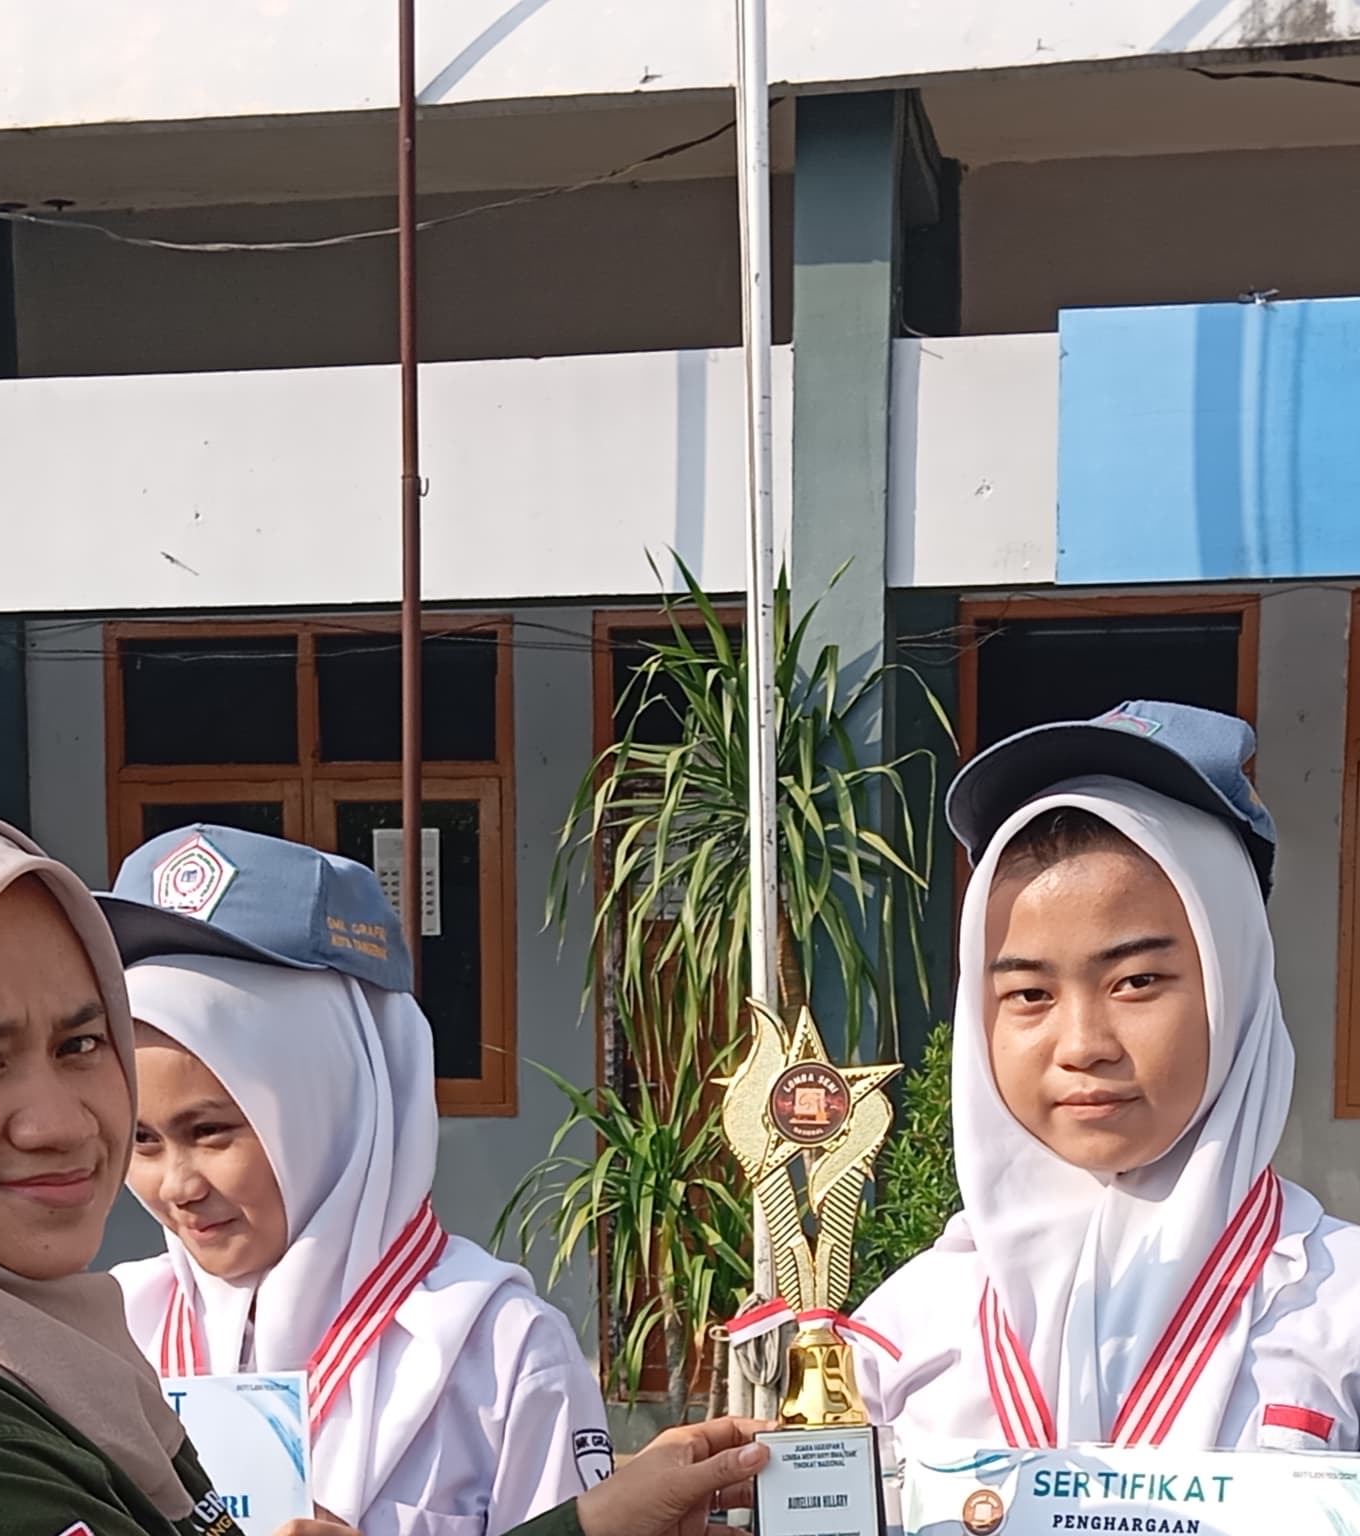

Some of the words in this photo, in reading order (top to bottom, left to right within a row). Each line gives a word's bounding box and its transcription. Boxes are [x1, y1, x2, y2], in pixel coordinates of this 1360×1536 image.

[783, 1073, 814, 1093] LOMBA
[818, 1075, 839, 1094] SENI
[1033, 1470, 1234, 1503] SERTIFIKAT
[1052, 1514, 1200, 1534] PENGHARGAAN
